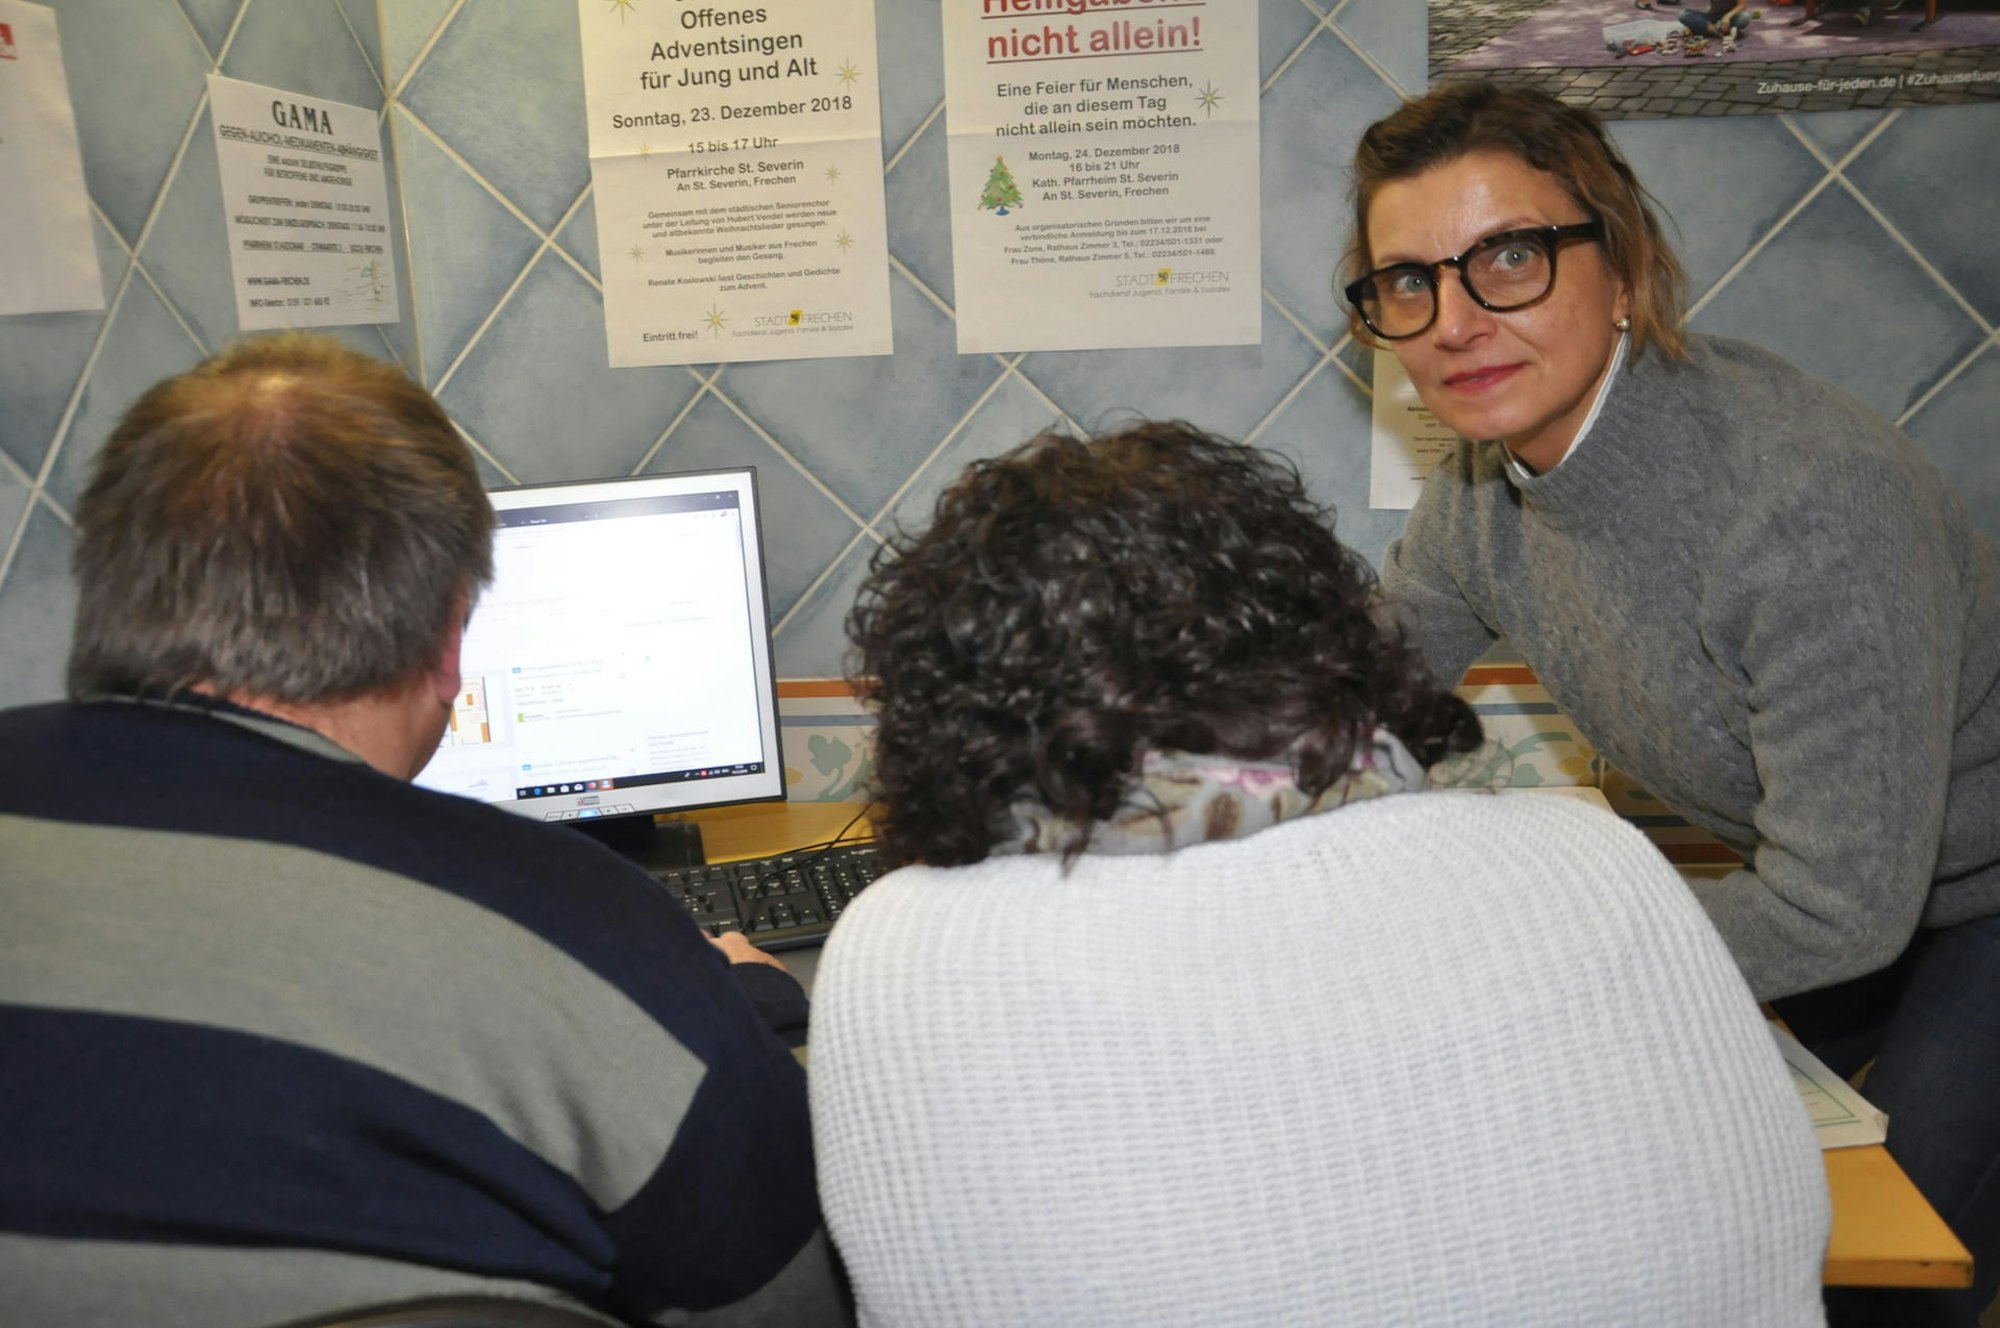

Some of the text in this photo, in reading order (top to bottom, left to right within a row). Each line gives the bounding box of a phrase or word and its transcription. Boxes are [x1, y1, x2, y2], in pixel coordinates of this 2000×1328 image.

[680, 8, 766, 29] Offenes
[988, 16, 1200, 58] nicht allein!
[650, 34, 802, 59] Adventsingen
[640, 57, 817, 89] für Jung und Alt
[997, 75, 1192, 97] Eine Feier für Menschen,
[1757, 76, 1896, 94] Zuhause-für-jeden.de
[612, 95, 851, 128] Sonntag, 23. Dezember 2018
[1024, 96, 1166, 115] die an diesem Tag
[272, 100, 333, 135] GAMA
[996, 115, 1196, 136] nicht allein sein möchten.
[688, 137, 778, 154] 15 bis 17 Uhr
[1028, 143, 1179, 161] Montag, 24. Dezember 2018
[666, 161, 803, 178] Pfarrkirche St. Severin
[1069, 160, 1140, 172] 16 bis 21 Uhr
[676, 176, 796, 191] An St. Severin, Frechen
[1032, 172, 1178, 187] Kath. Pfarrheim St. Severin
[1042, 186, 1168, 200] An St. Severin, Frechen
[647, 210, 694, 219] Gemeinsam
[727, 204, 774, 212] städtischen
[775, 200, 829, 209] Seniorenchor
[668, 227, 714, 236] altbekannte
[715, 223, 784, 232] Weihnachtslieder
[786, 220, 826, 230] gesungen.
[1020, 232, 1068, 240] verbindliche
[1148, 225, 1192, 234] 17.12.2018
[1031, 221, 1102, 231] organisatorischen
[665, 247, 717, 256] Musikerinnen
[697, 255, 734, 264] begleiten
[735, 272, 785, 280] Geschichten
[803, 268, 840, 276] Gedichte
[1116, 271, 1229, 287] STADT FRECHEN
[755, 312, 852, 326] STADT FRECHEN
[642, 330, 697, 342] Eintritt frei!
